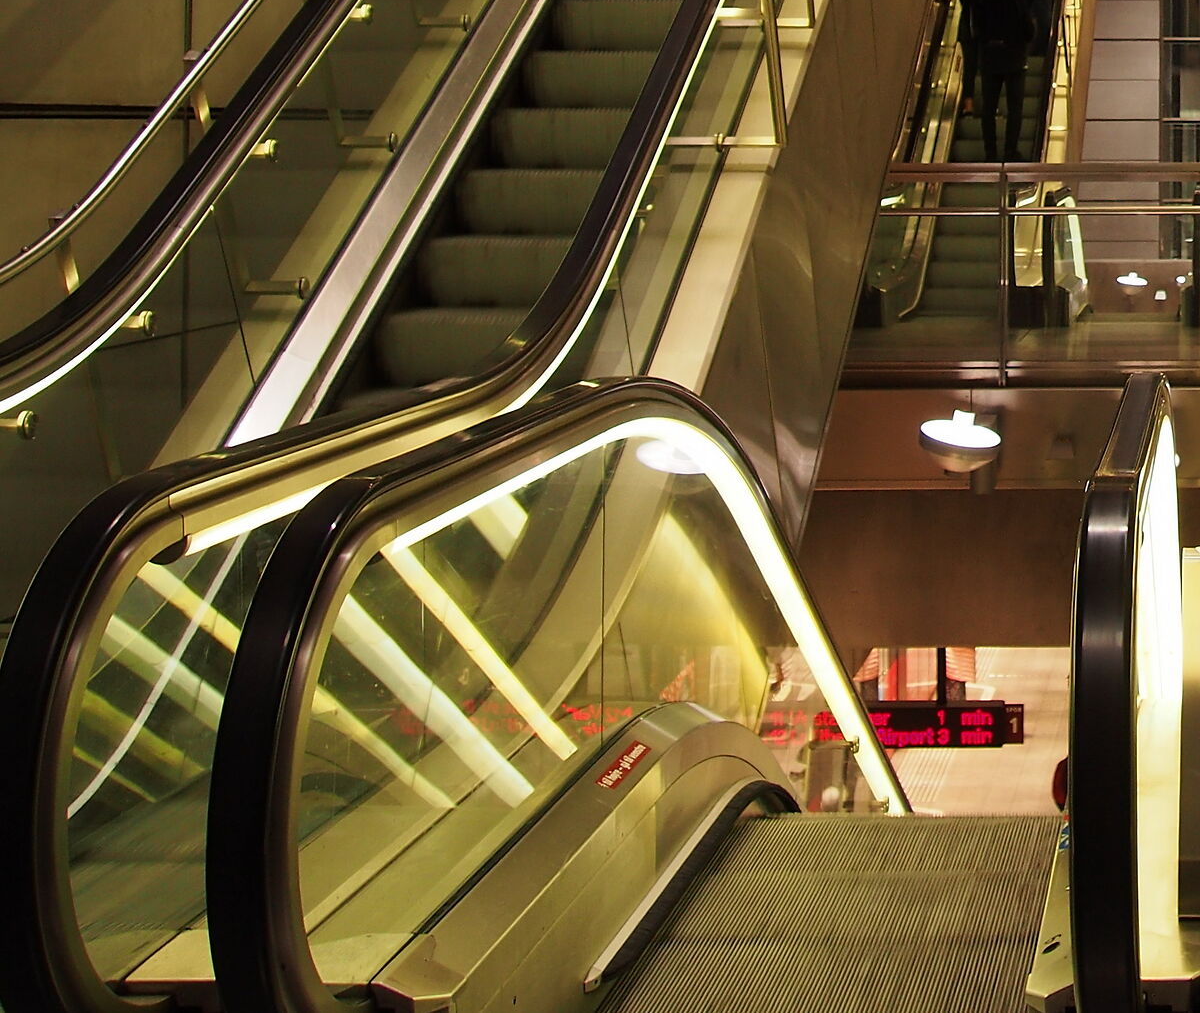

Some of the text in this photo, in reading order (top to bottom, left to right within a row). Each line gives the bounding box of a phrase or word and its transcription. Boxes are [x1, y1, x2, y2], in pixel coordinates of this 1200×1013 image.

[937, 709, 945, 725] 1
[960, 709, 993, 726] min
[1009, 717, 1017, 733] 1
[937, 728, 951, 745] 3
[960, 727, 993, 746] min
